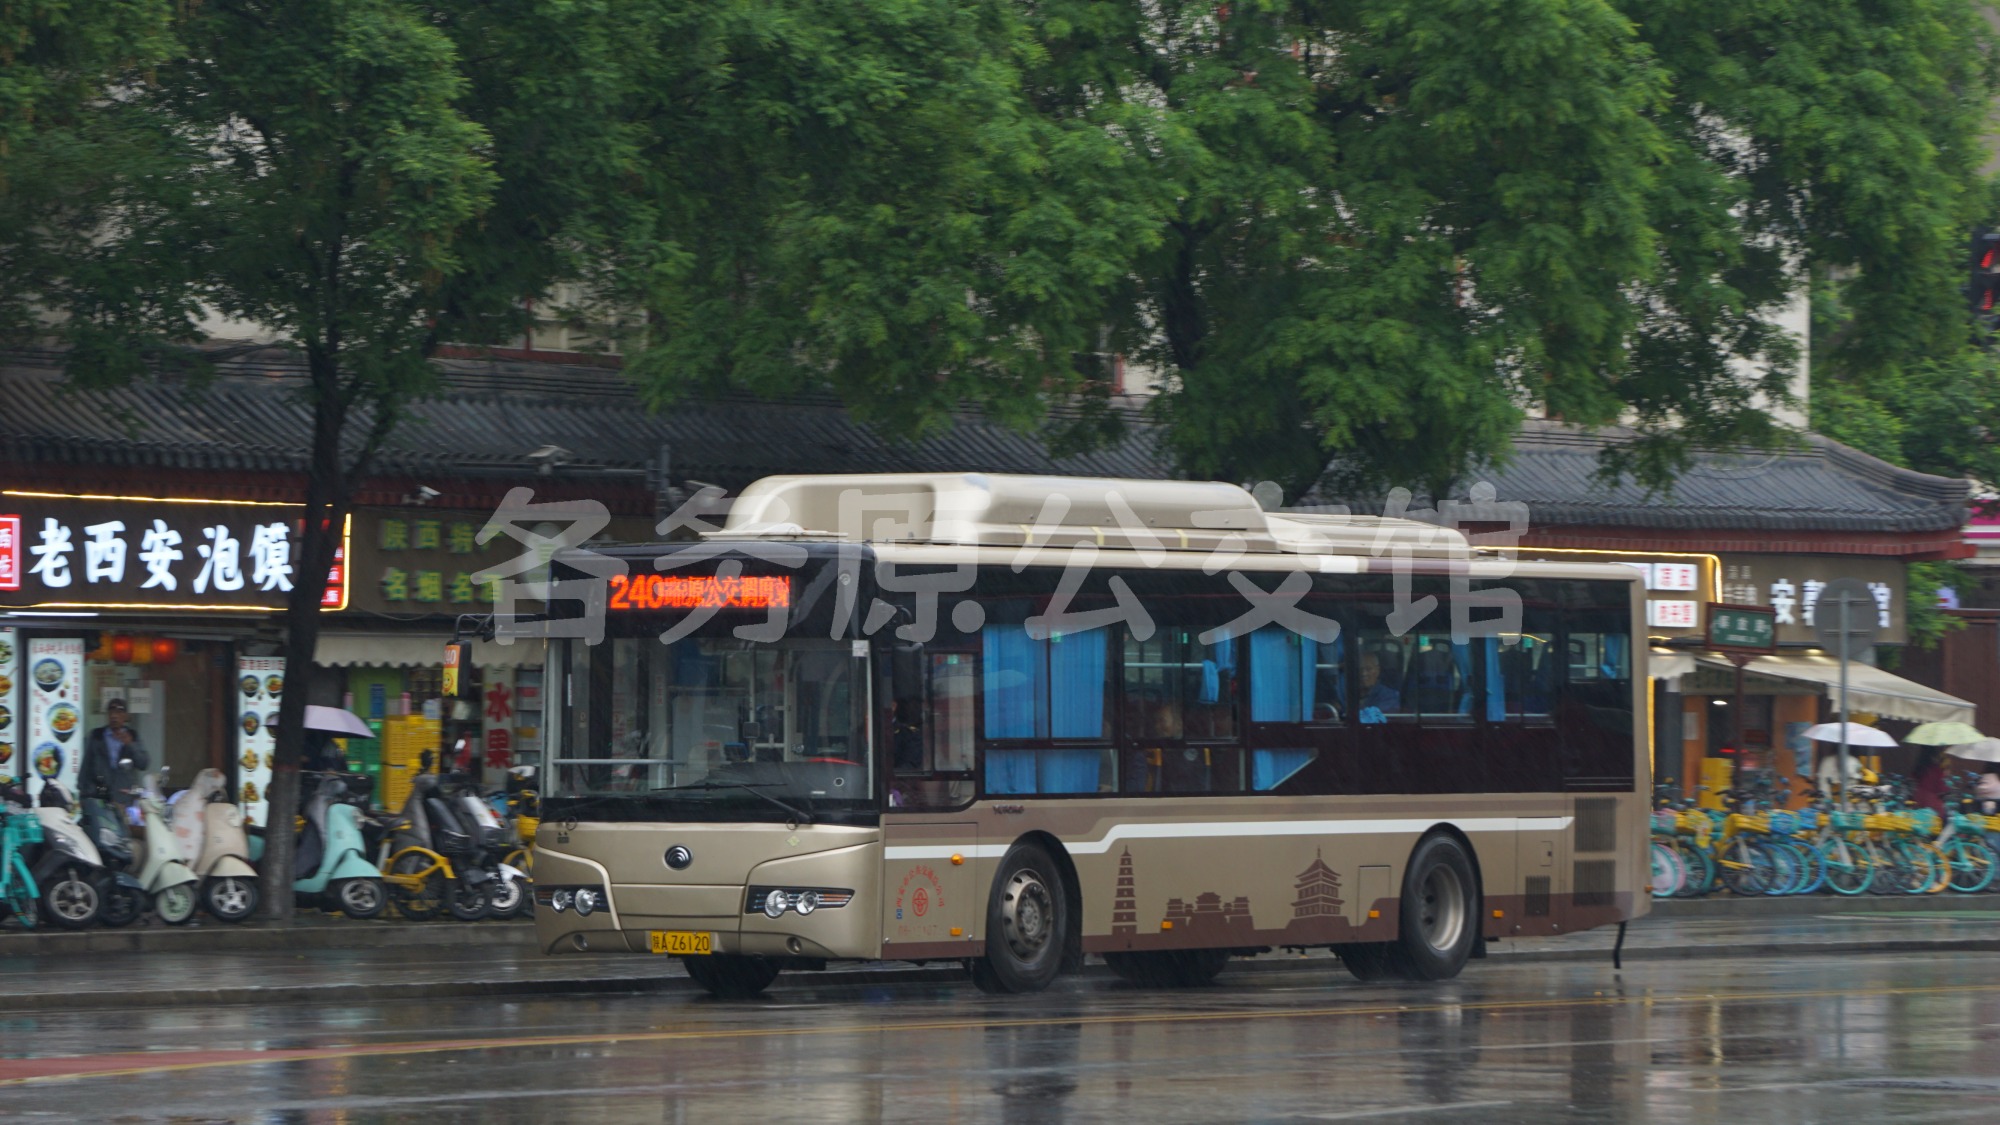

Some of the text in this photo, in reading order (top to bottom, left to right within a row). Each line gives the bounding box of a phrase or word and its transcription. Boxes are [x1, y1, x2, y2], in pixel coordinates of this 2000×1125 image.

[28, 517, 294, 594] 老西安泡馍
[485, 682, 513, 769] 水果
